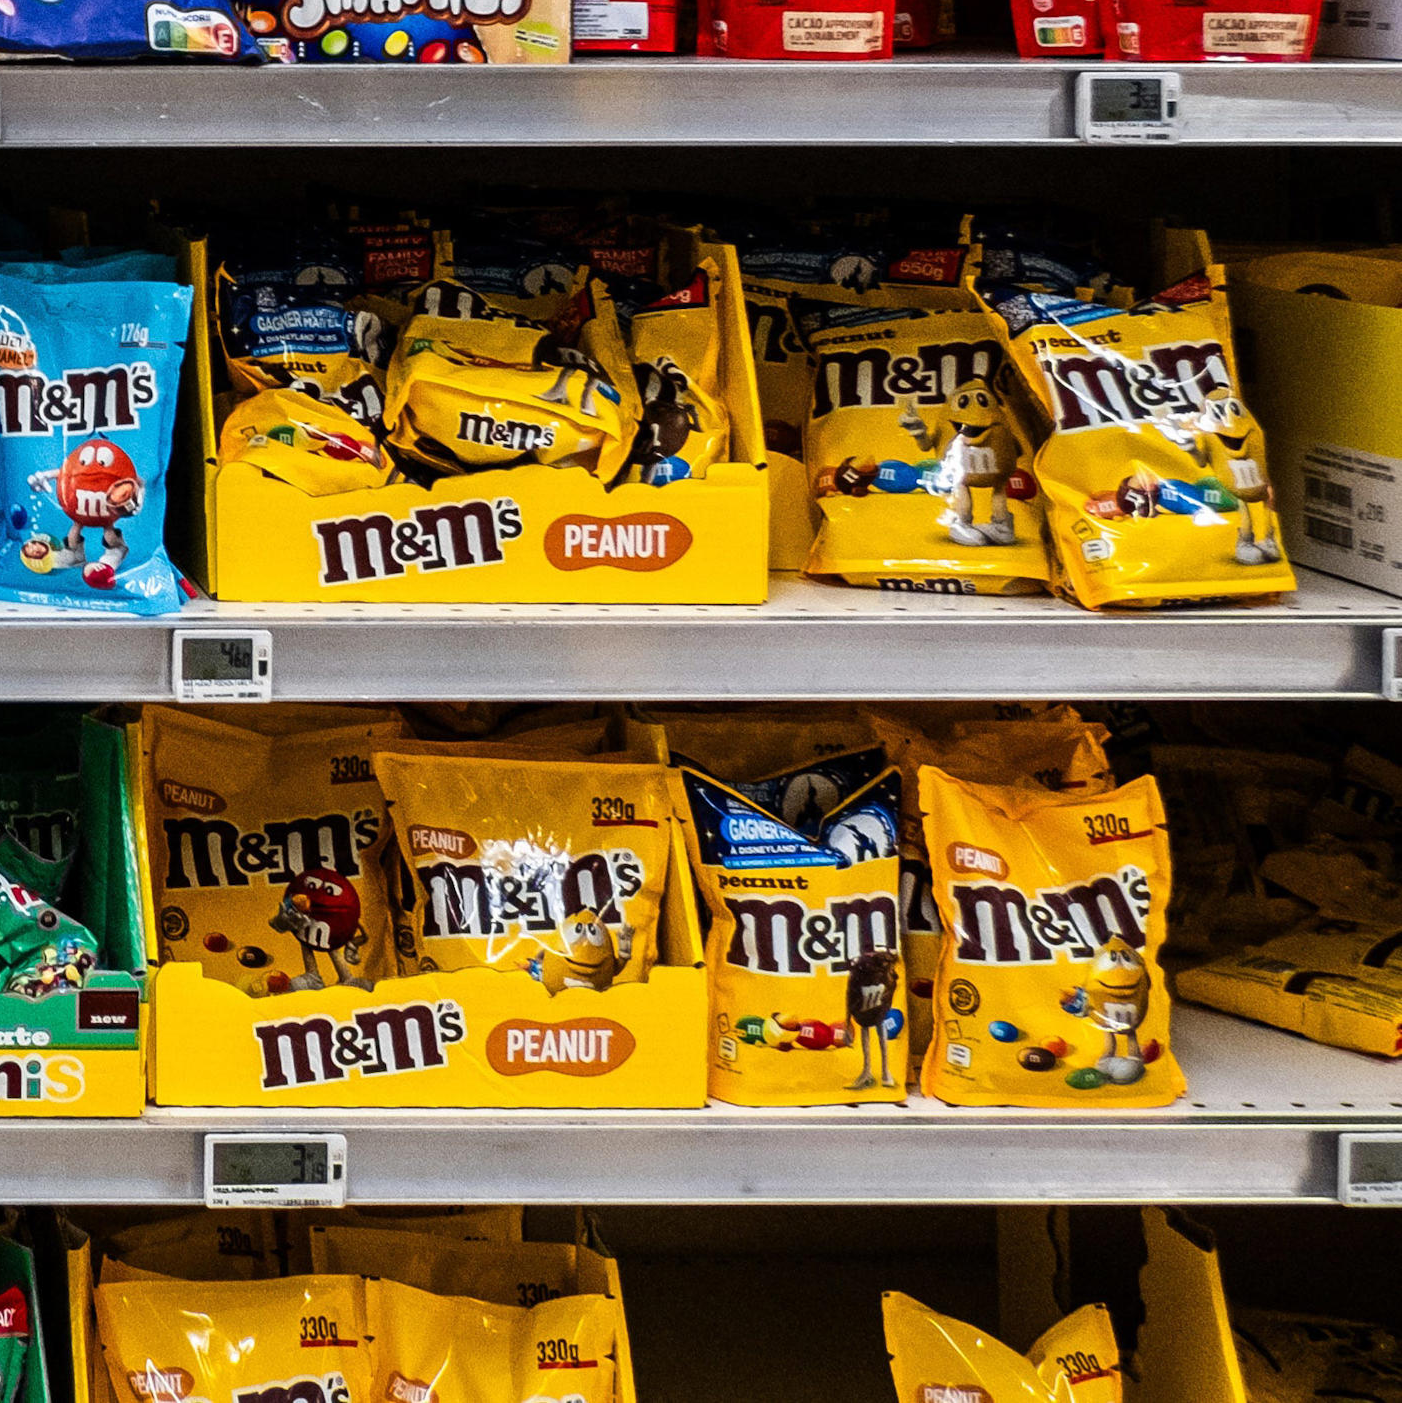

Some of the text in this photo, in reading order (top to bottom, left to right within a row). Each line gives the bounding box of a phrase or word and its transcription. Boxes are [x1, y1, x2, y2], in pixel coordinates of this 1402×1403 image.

[787, 18, 823, 29] CACAO
[1208, 17, 1246, 29] CACAO
[311, 498, 523, 587] m&m's
[563, 524, 670, 559] PEANUT
[163, 784, 215, 810] PEANUT
[591, 797, 635, 822] 330g
[1083, 812, 1131, 839] 330g
[412, 829, 466, 855] PEANUT
[953, 845, 1003, 876] PEANUT
[717, 873, 809, 892] peanut
[90, 1012, 127, 1024] new
[253, 1000, 464, 1091] m&m's
[506, 1030, 614, 1063] PEANUT
[300, 1317, 339, 1341] 330g
[537, 1339, 580, 1364] 330g
[1057, 1351, 1102, 1378] 330g
